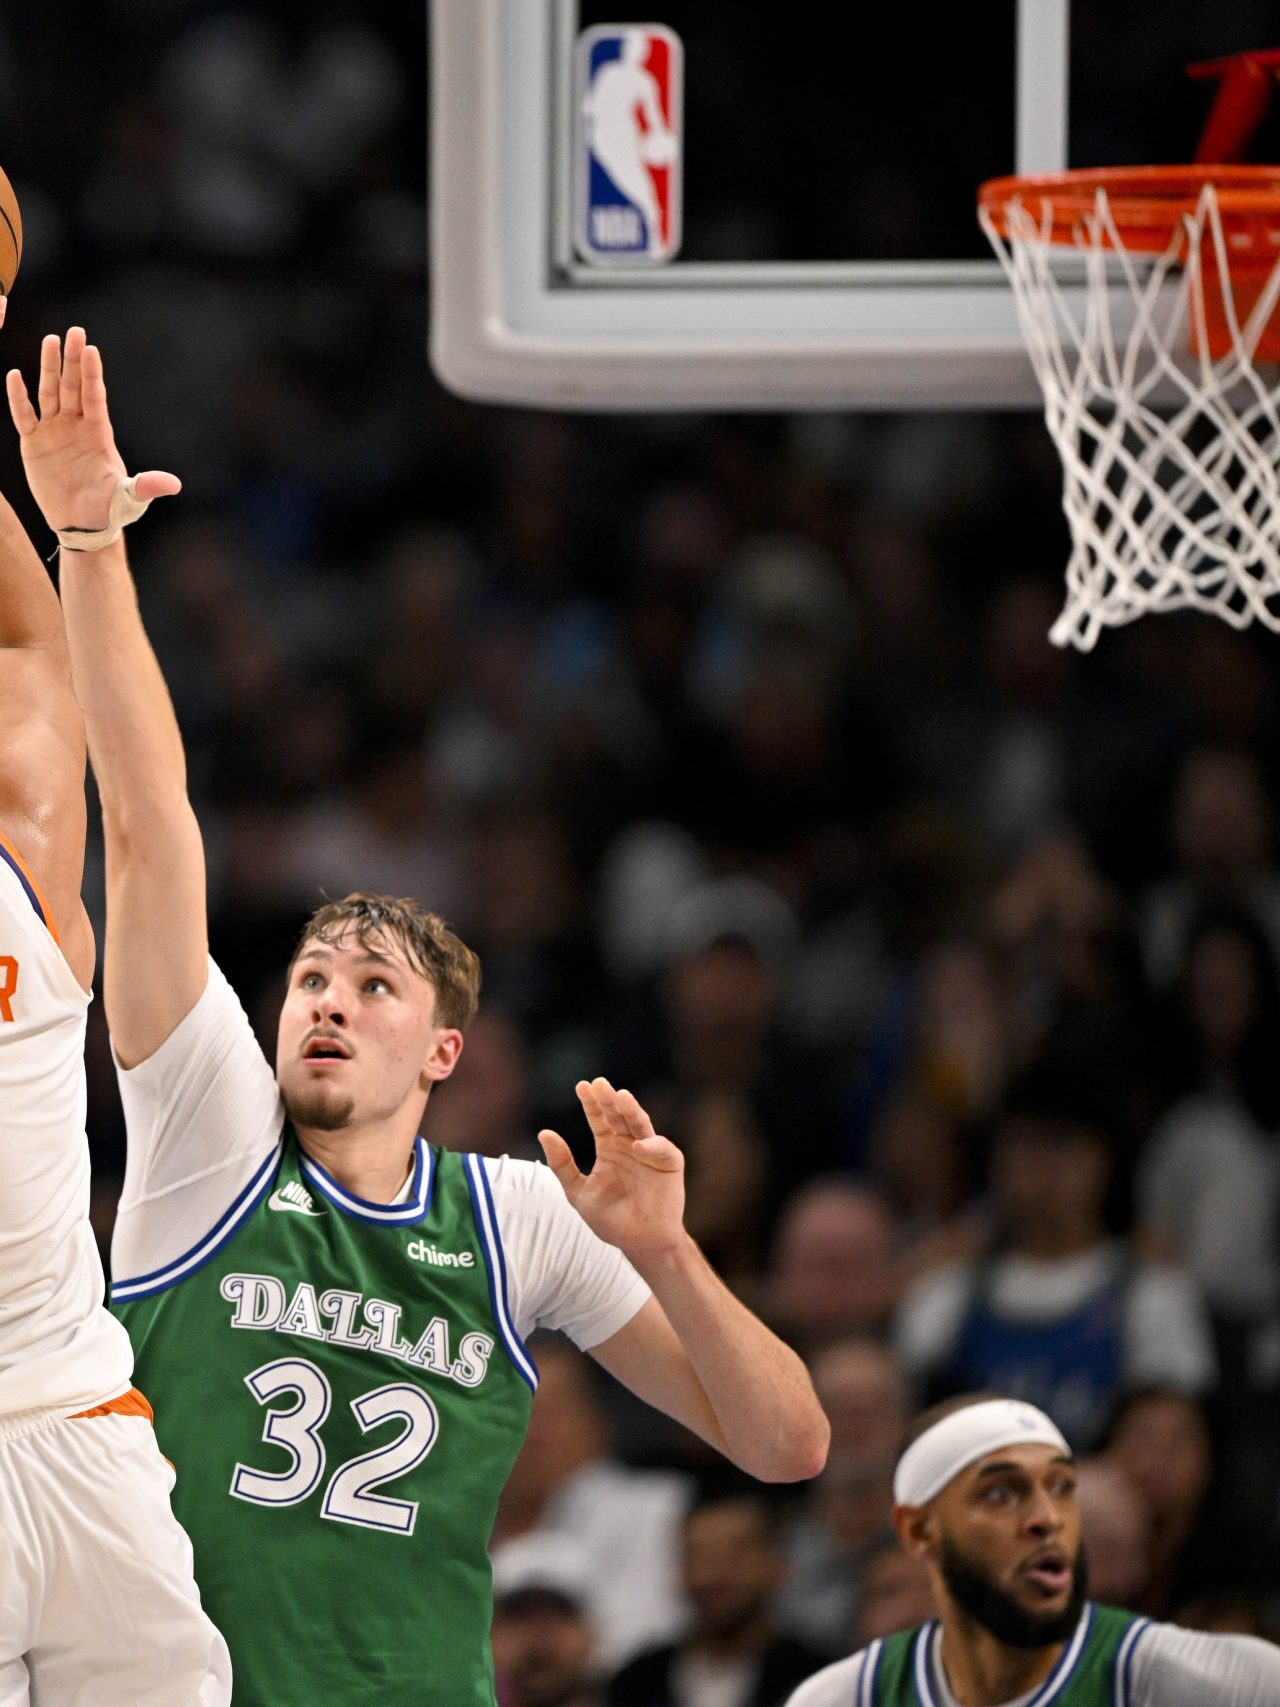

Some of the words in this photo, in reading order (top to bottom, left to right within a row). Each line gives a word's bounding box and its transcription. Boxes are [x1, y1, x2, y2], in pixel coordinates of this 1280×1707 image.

[407, 1239, 475, 1267] chime
[220, 1272, 495, 1388] DALLAS
[229, 1357, 440, 1537] 32
